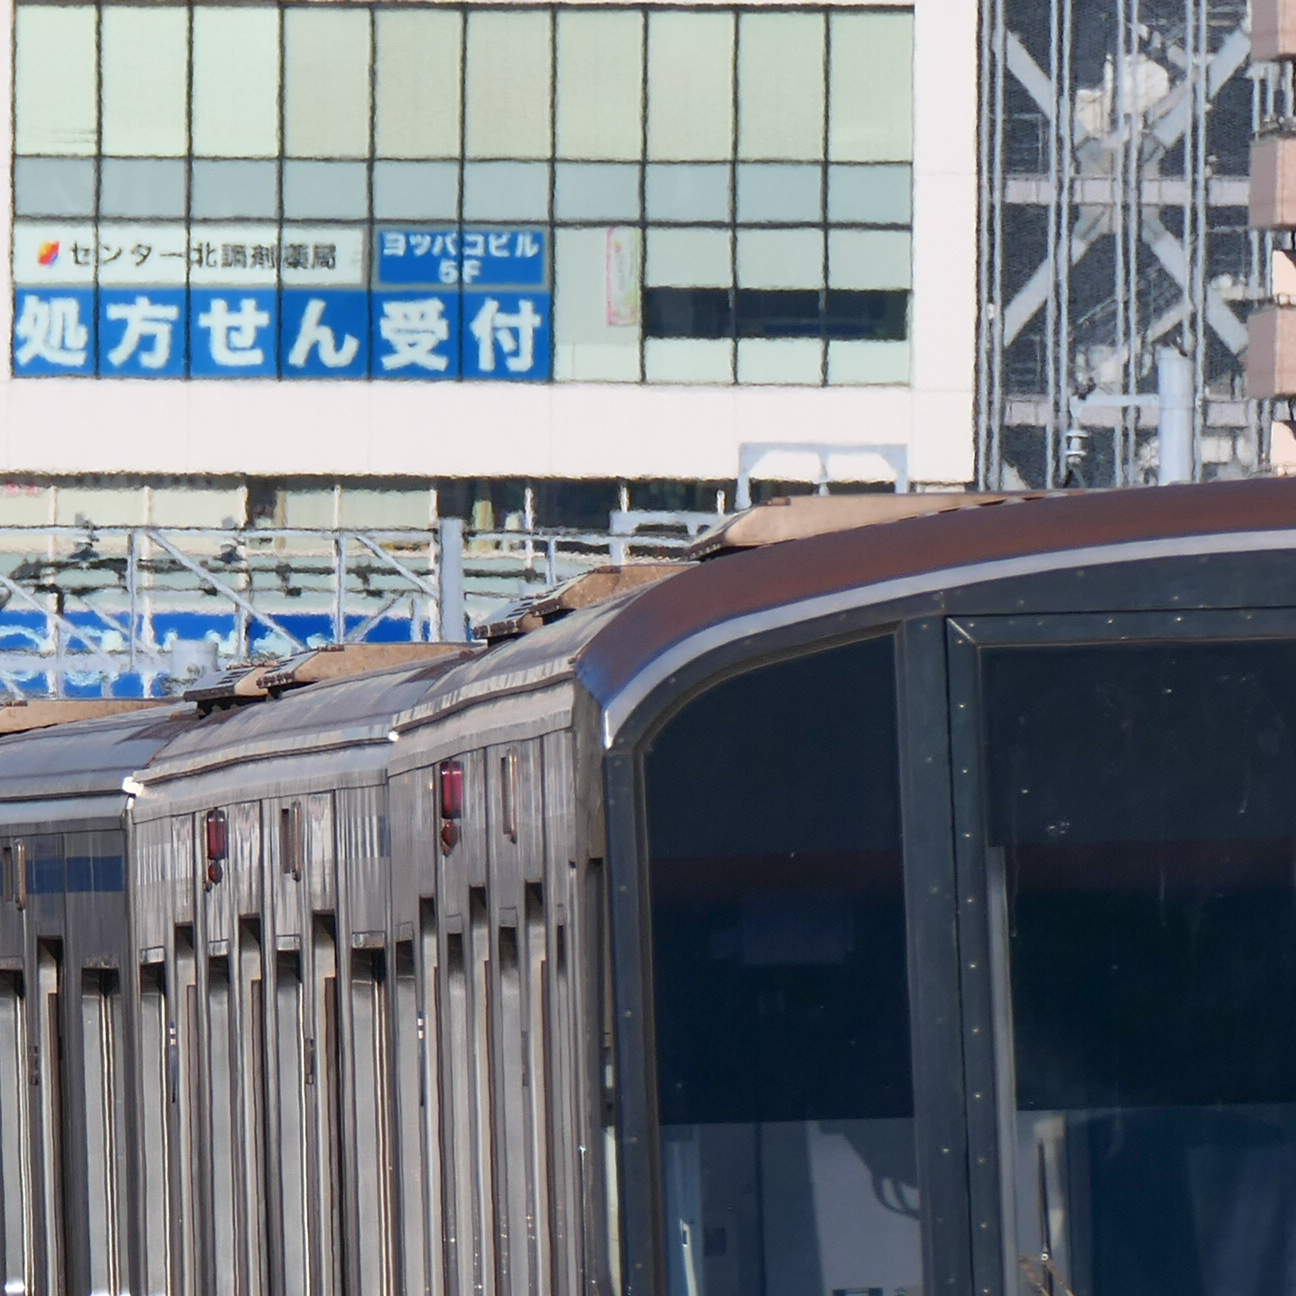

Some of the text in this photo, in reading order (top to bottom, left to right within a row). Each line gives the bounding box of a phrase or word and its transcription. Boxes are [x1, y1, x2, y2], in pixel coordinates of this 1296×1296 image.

[16, 294, 542, 373] 処方せん受付
